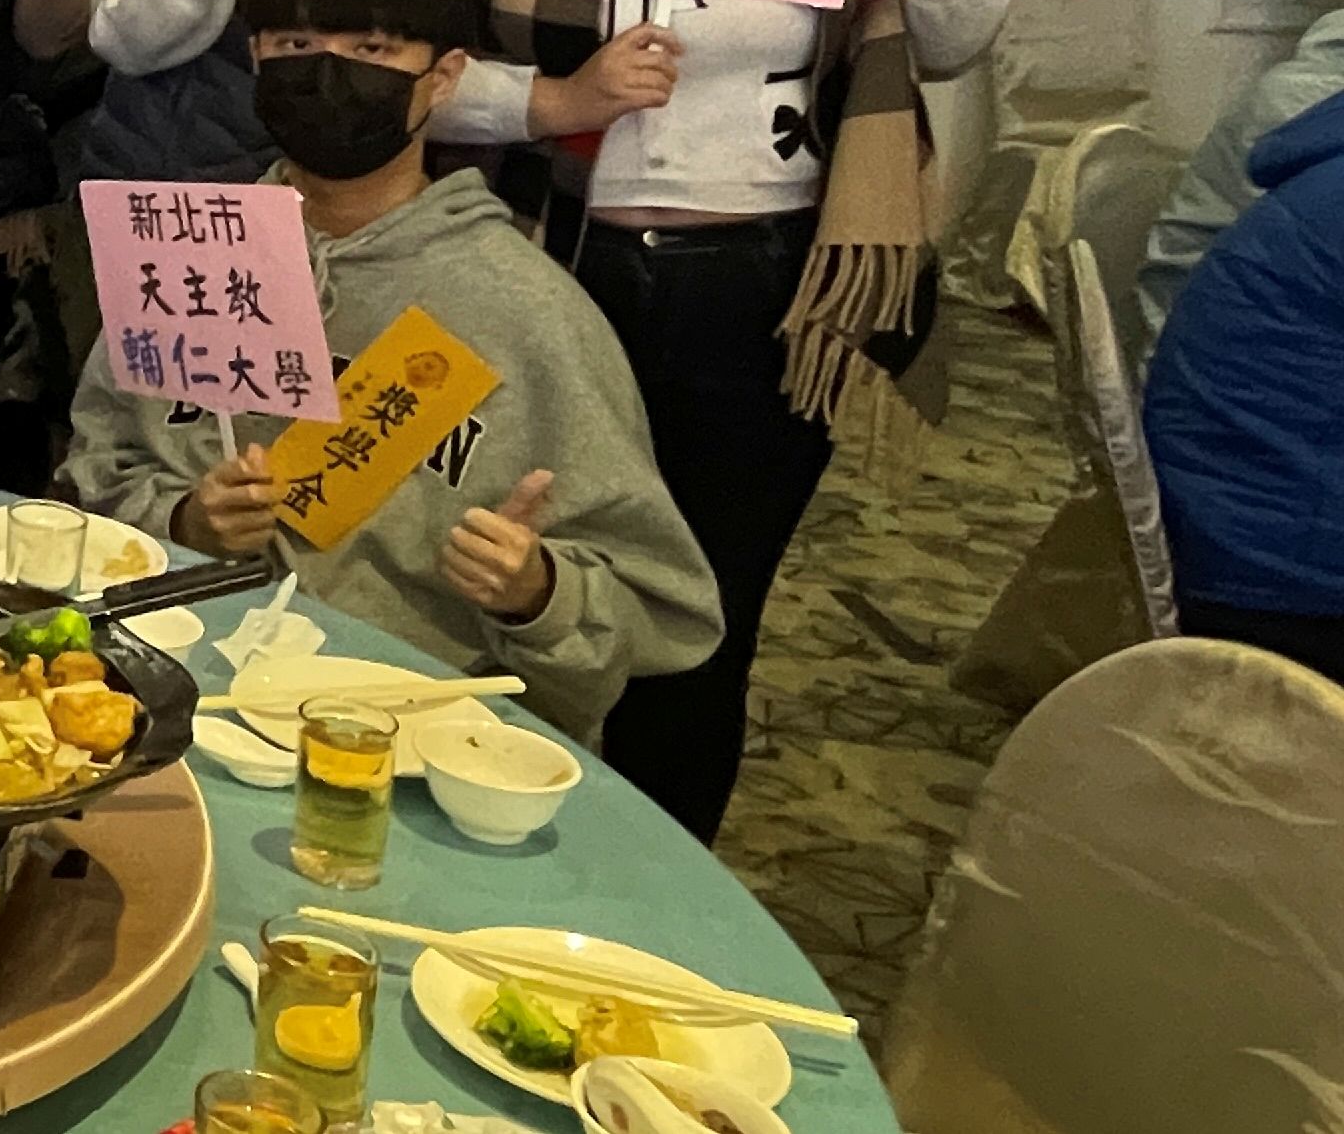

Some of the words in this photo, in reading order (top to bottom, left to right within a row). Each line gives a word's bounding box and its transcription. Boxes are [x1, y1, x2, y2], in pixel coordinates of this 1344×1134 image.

[126, 192, 247, 246] 新北市
[138, 262, 274, 326] 天主教
[120, 326, 313, 409] 輔仁大學
[281, 380, 420, 519] 獎學金
